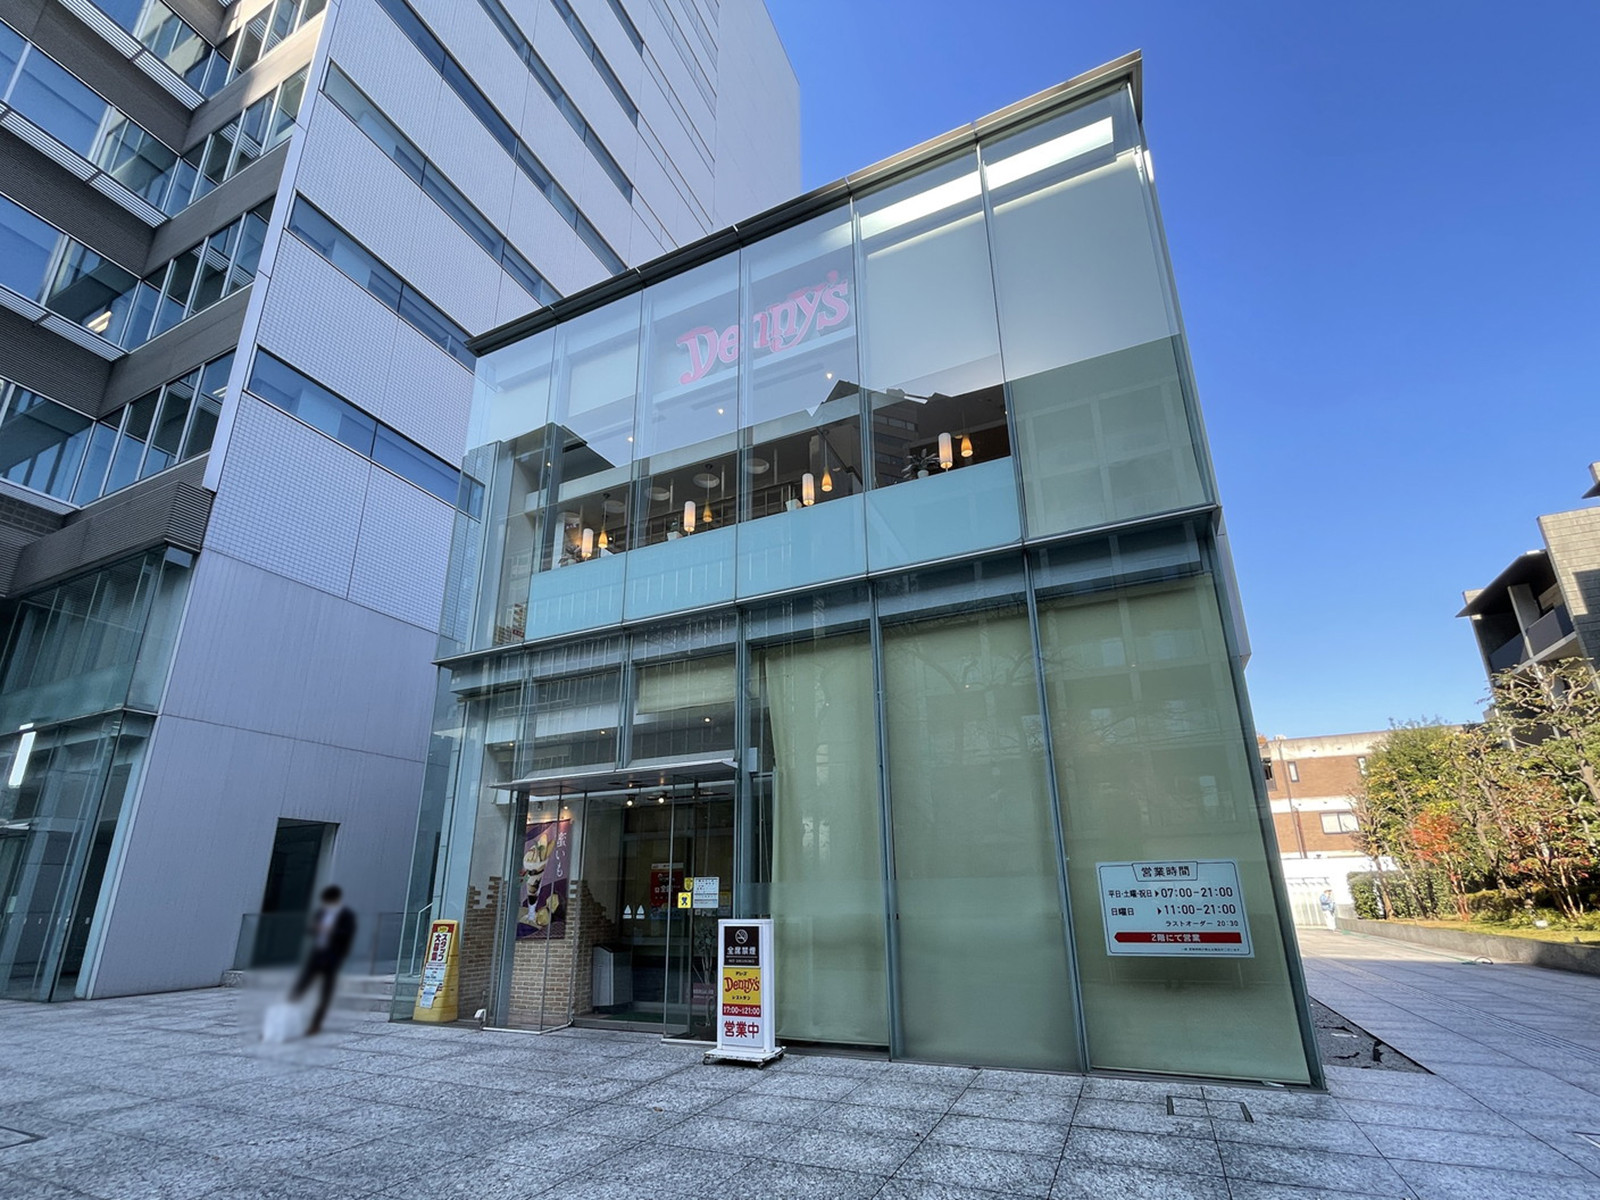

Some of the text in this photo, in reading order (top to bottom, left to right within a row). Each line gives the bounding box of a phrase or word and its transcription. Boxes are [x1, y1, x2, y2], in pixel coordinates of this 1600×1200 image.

[1141, 866, 1190, 877] 営業時間
[1111, 907, 1135, 916] 日曜日
[1151, 933, 1201, 943] 2階にて営業
[724, 976, 760, 993] Denny's
[724, 1020, 760, 1039] 営業中
